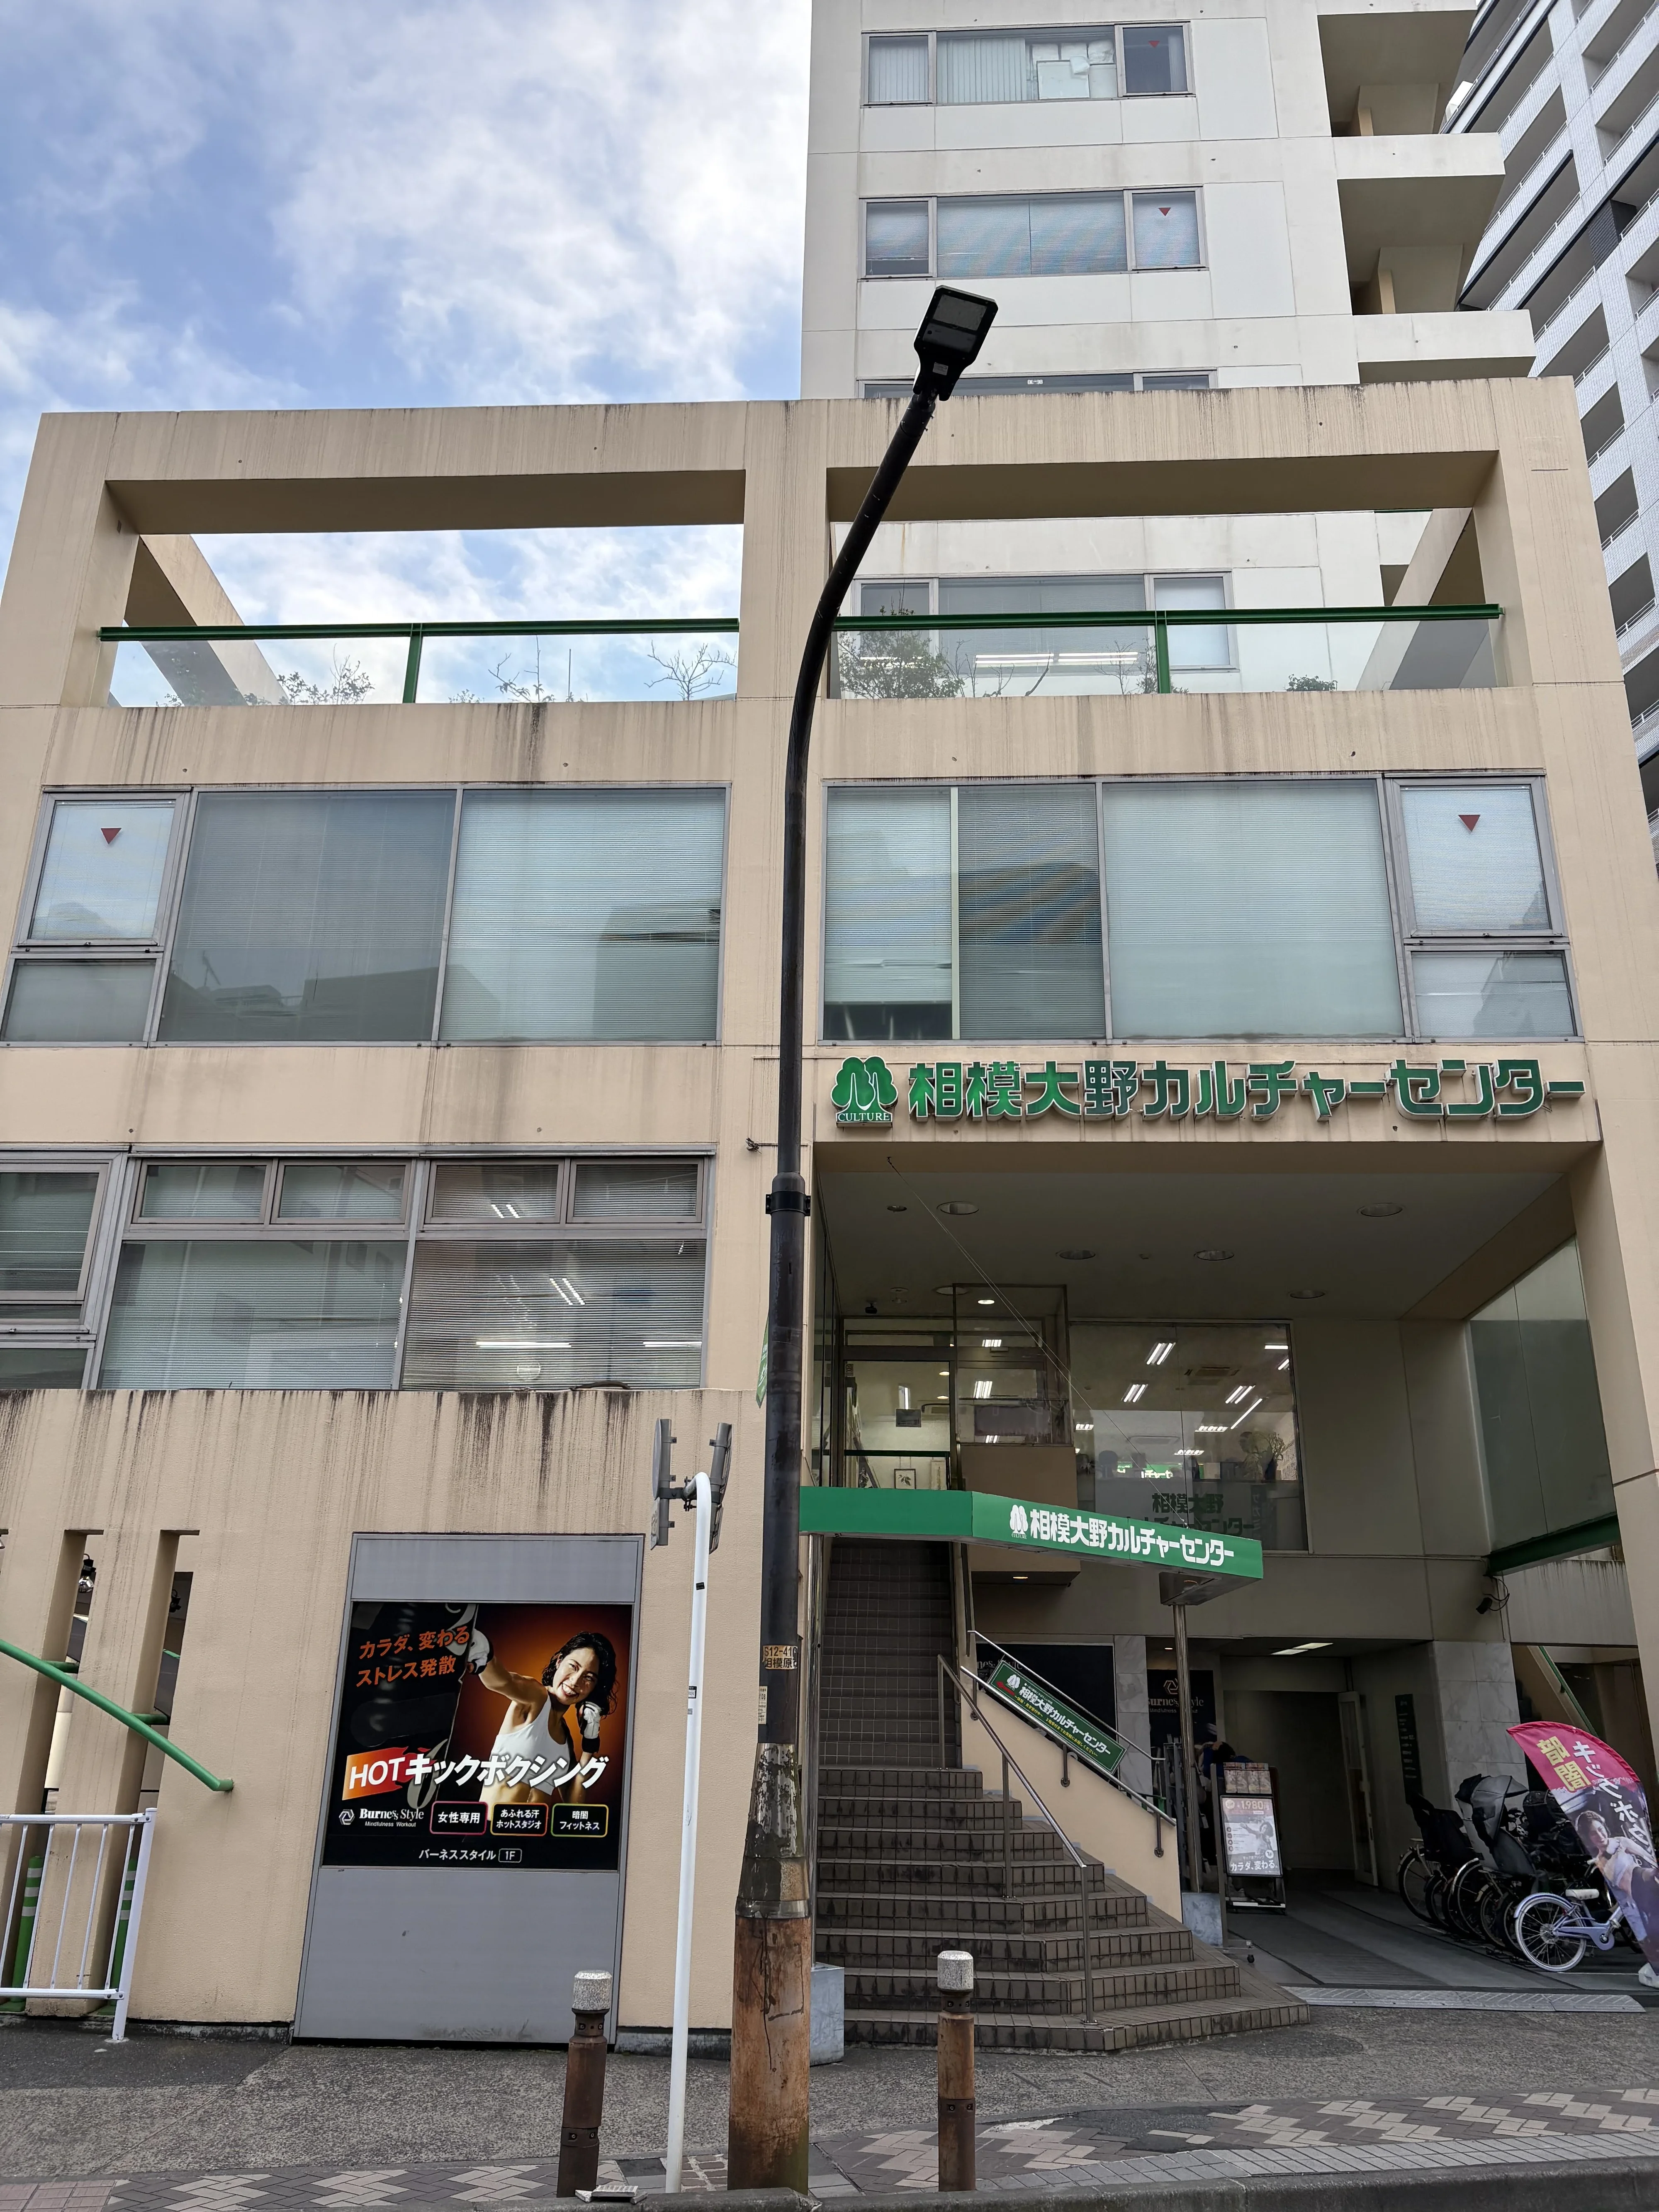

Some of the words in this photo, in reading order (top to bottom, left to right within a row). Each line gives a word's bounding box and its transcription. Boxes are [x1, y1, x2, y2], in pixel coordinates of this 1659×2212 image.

[908, 1059, 1586, 1122] 相模大野カルチャーセンター
[837, 1112, 892, 1122] CULTURE
[1030, 1509, 1234, 1567] 相模大野カルチャーセンター
[358, 1626, 470, 1660] カラダ、変わる
[764, 1657, 797, 1668] 相模原
[355, 1655, 457, 1687] ストレス発散
[1019, 1686, 1111, 1755] 相模大野カルチャーセンター
[400, 1808, 424, 1821] Style
[438, 1812, 480, 1824] 女性専用
[500, 1809, 540, 1819] あふれる汗
[572, 1810, 589, 1820] 暗闇
[496, 1820, 542, 1829] ホットスタジオ
[559, 1821, 600, 1830] フィットネス
[418, 1848, 496, 1861] バーネススタイル
[505, 1850, 516, 1861] 1F
